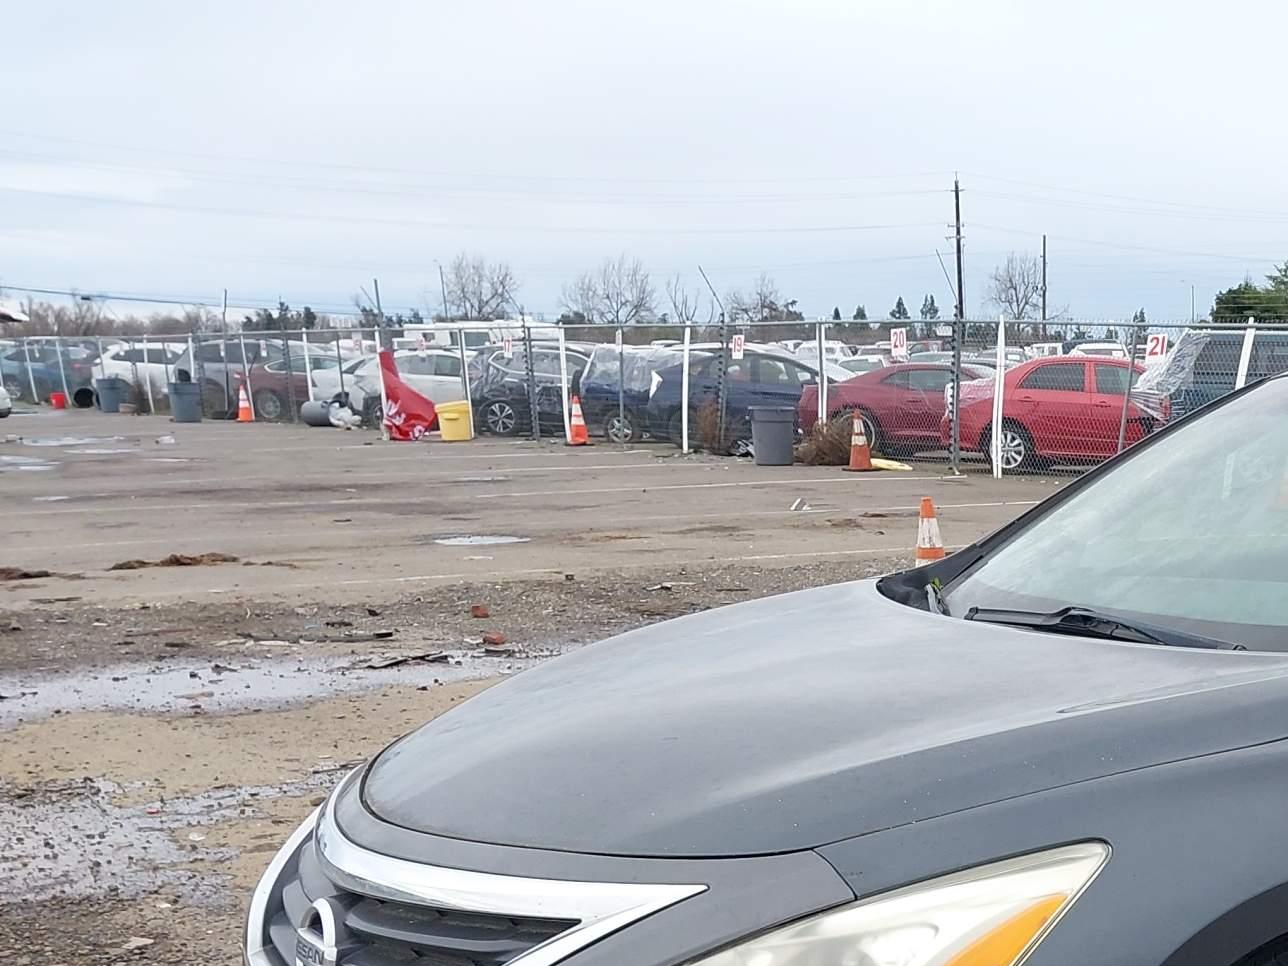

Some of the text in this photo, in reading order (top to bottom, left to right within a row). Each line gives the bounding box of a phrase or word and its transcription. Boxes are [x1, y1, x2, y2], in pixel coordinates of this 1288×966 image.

[733, 336, 743, 353] 19
[892, 330, 905, 349] 20
[1149, 335, 1166, 356] 21
